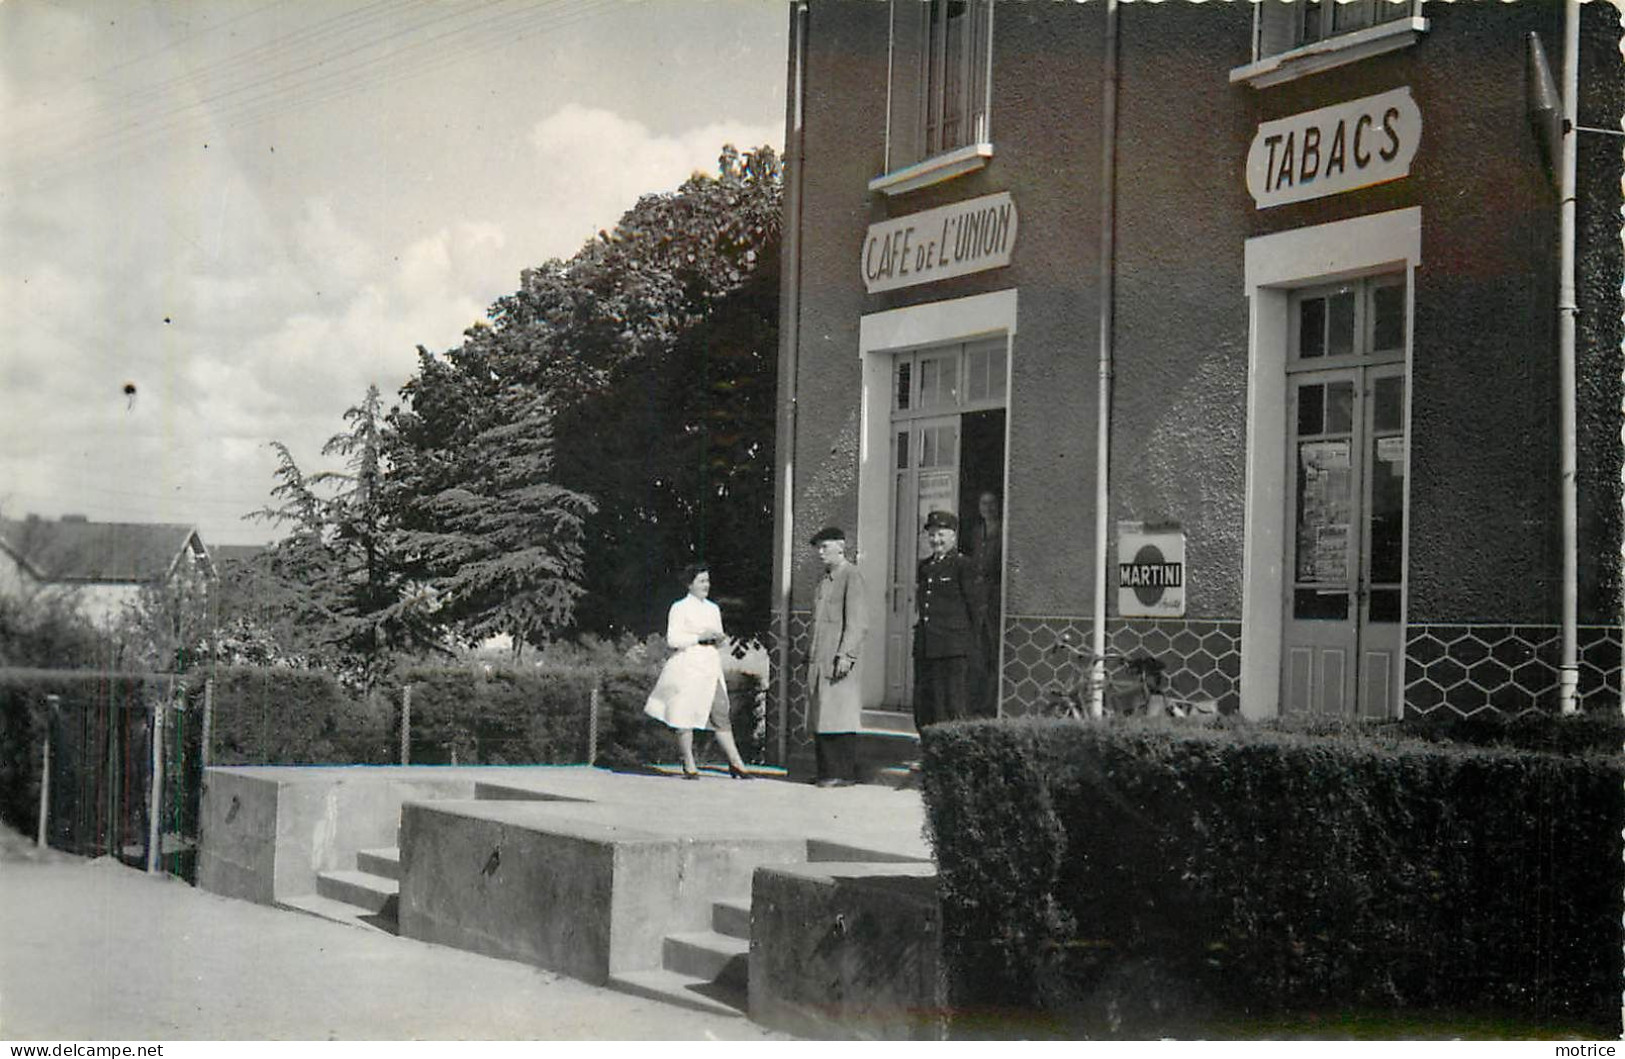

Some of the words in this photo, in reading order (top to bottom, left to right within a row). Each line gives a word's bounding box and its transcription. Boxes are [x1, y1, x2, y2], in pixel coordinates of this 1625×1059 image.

[1264, 107, 1400, 193] TABACS
[866, 227, 915, 280] CAFE
[938, 203, 1011, 267] L'UNION
[1120, 565, 1180, 586] MARTINI
